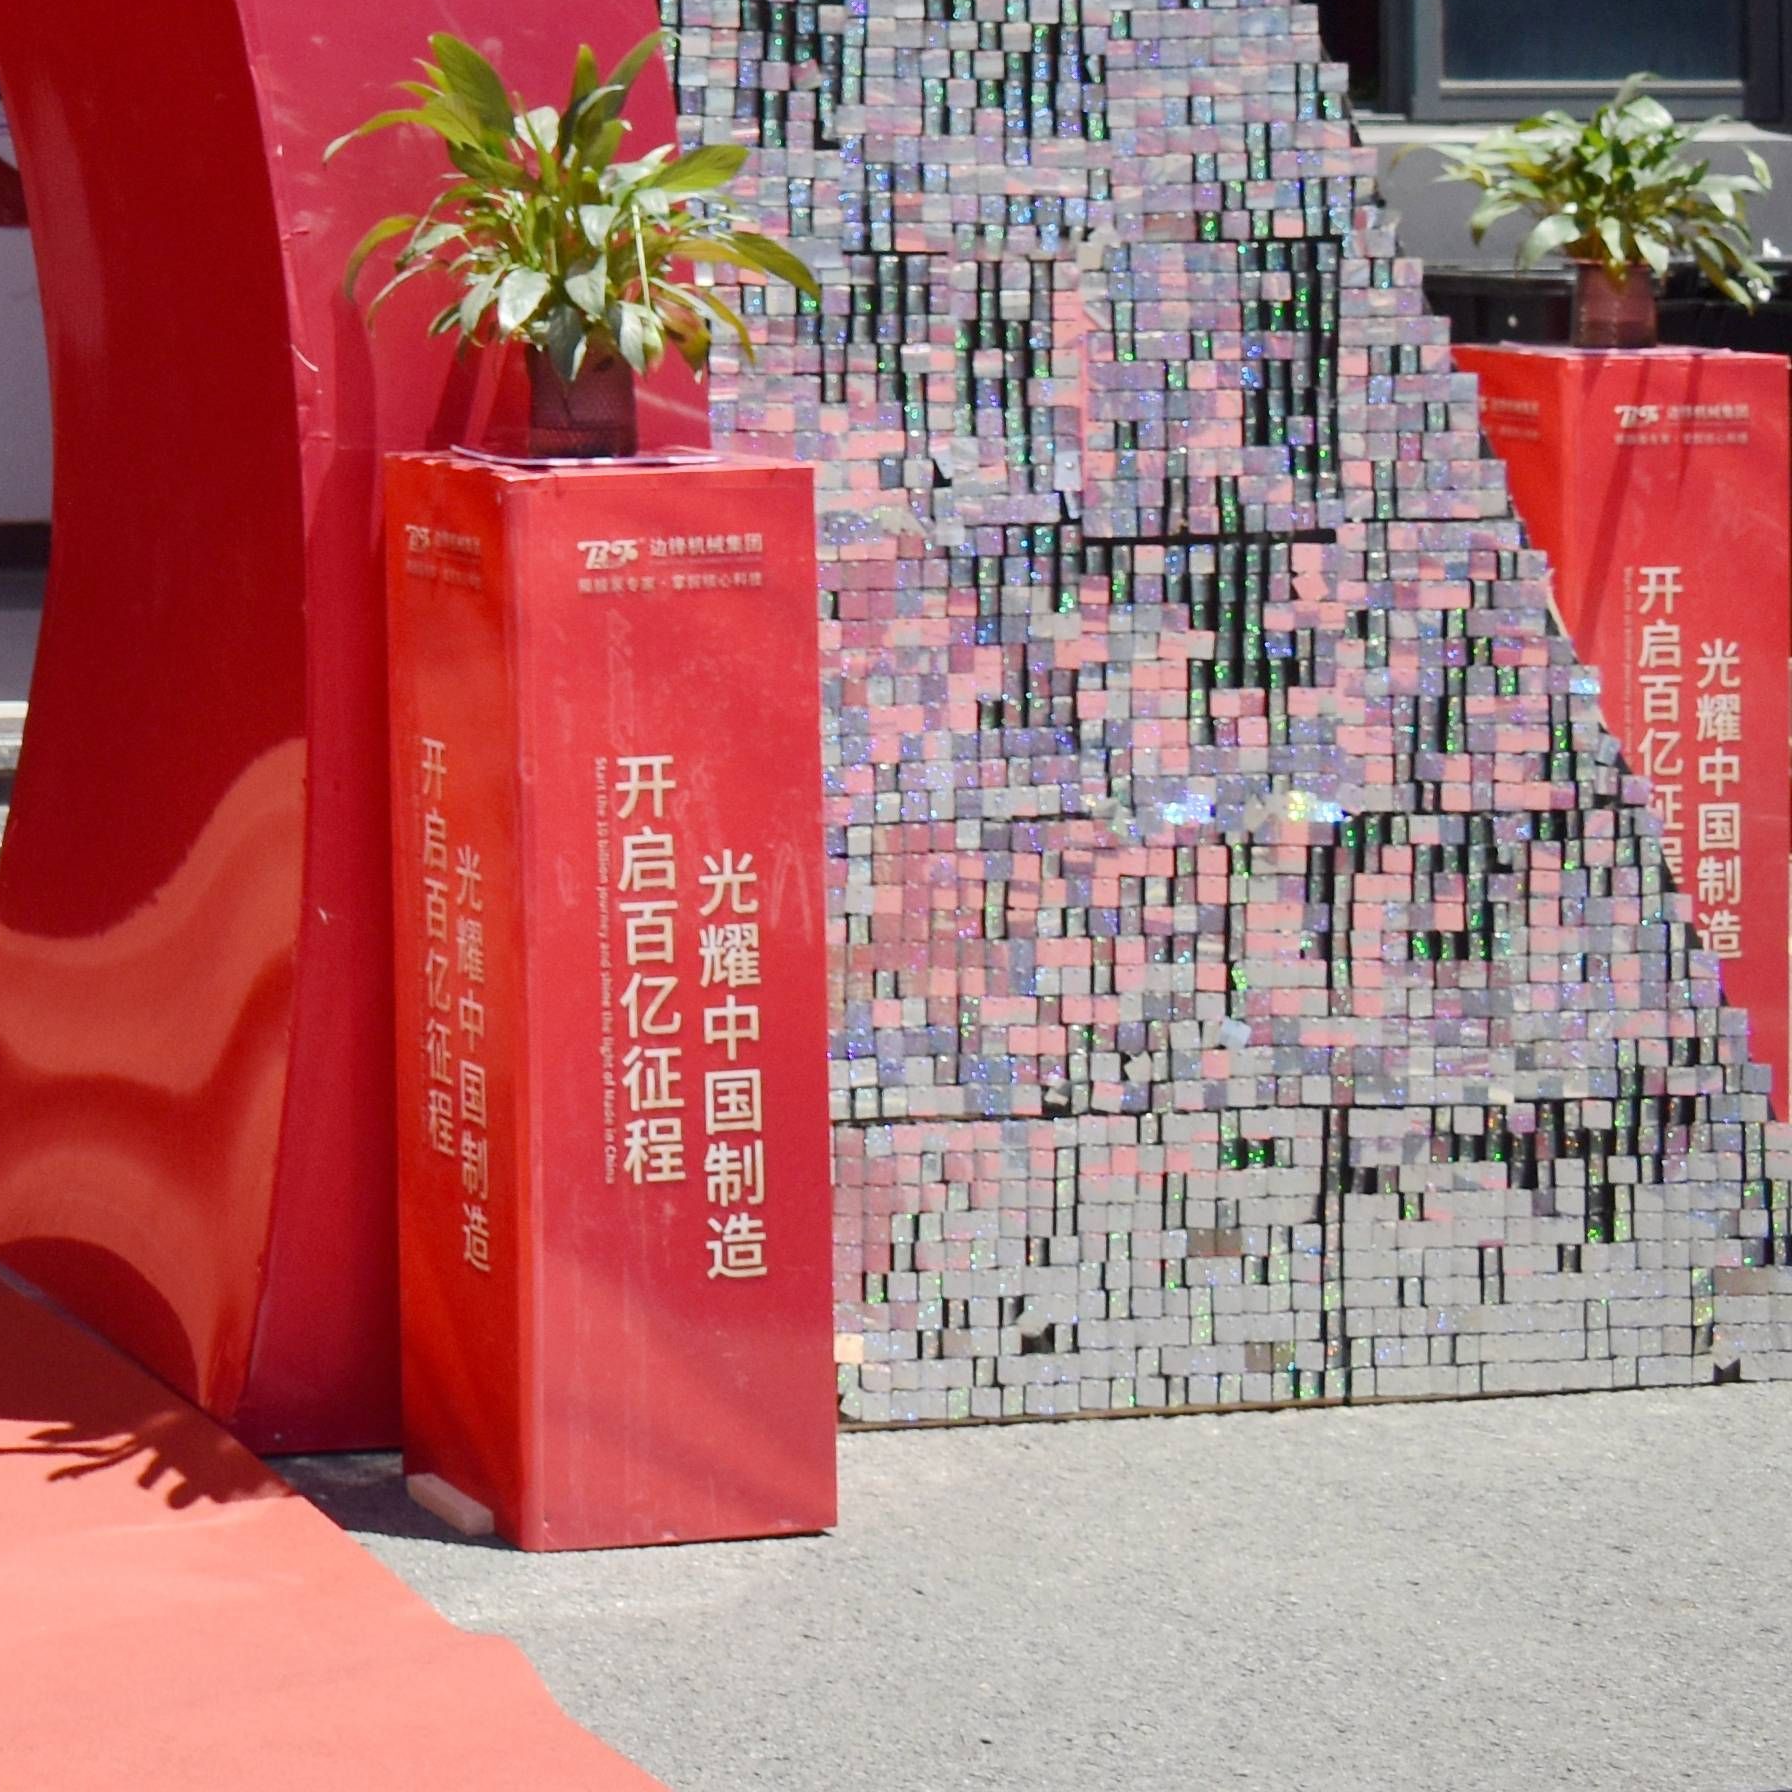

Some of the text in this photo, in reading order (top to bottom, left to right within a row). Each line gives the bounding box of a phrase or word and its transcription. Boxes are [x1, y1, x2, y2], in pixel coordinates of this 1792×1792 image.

[420, 735, 456, 1159] 开启百亿征程
[596, 757, 608, 790] Start
[615, 753, 687, 1186] 开启百亿征程
[1696, 637, 1743, 961] 光耀中国制造
[455, 844, 493, 1274] 光耀中国制造
[699, 848, 769, 1281] 光耀中国制造
